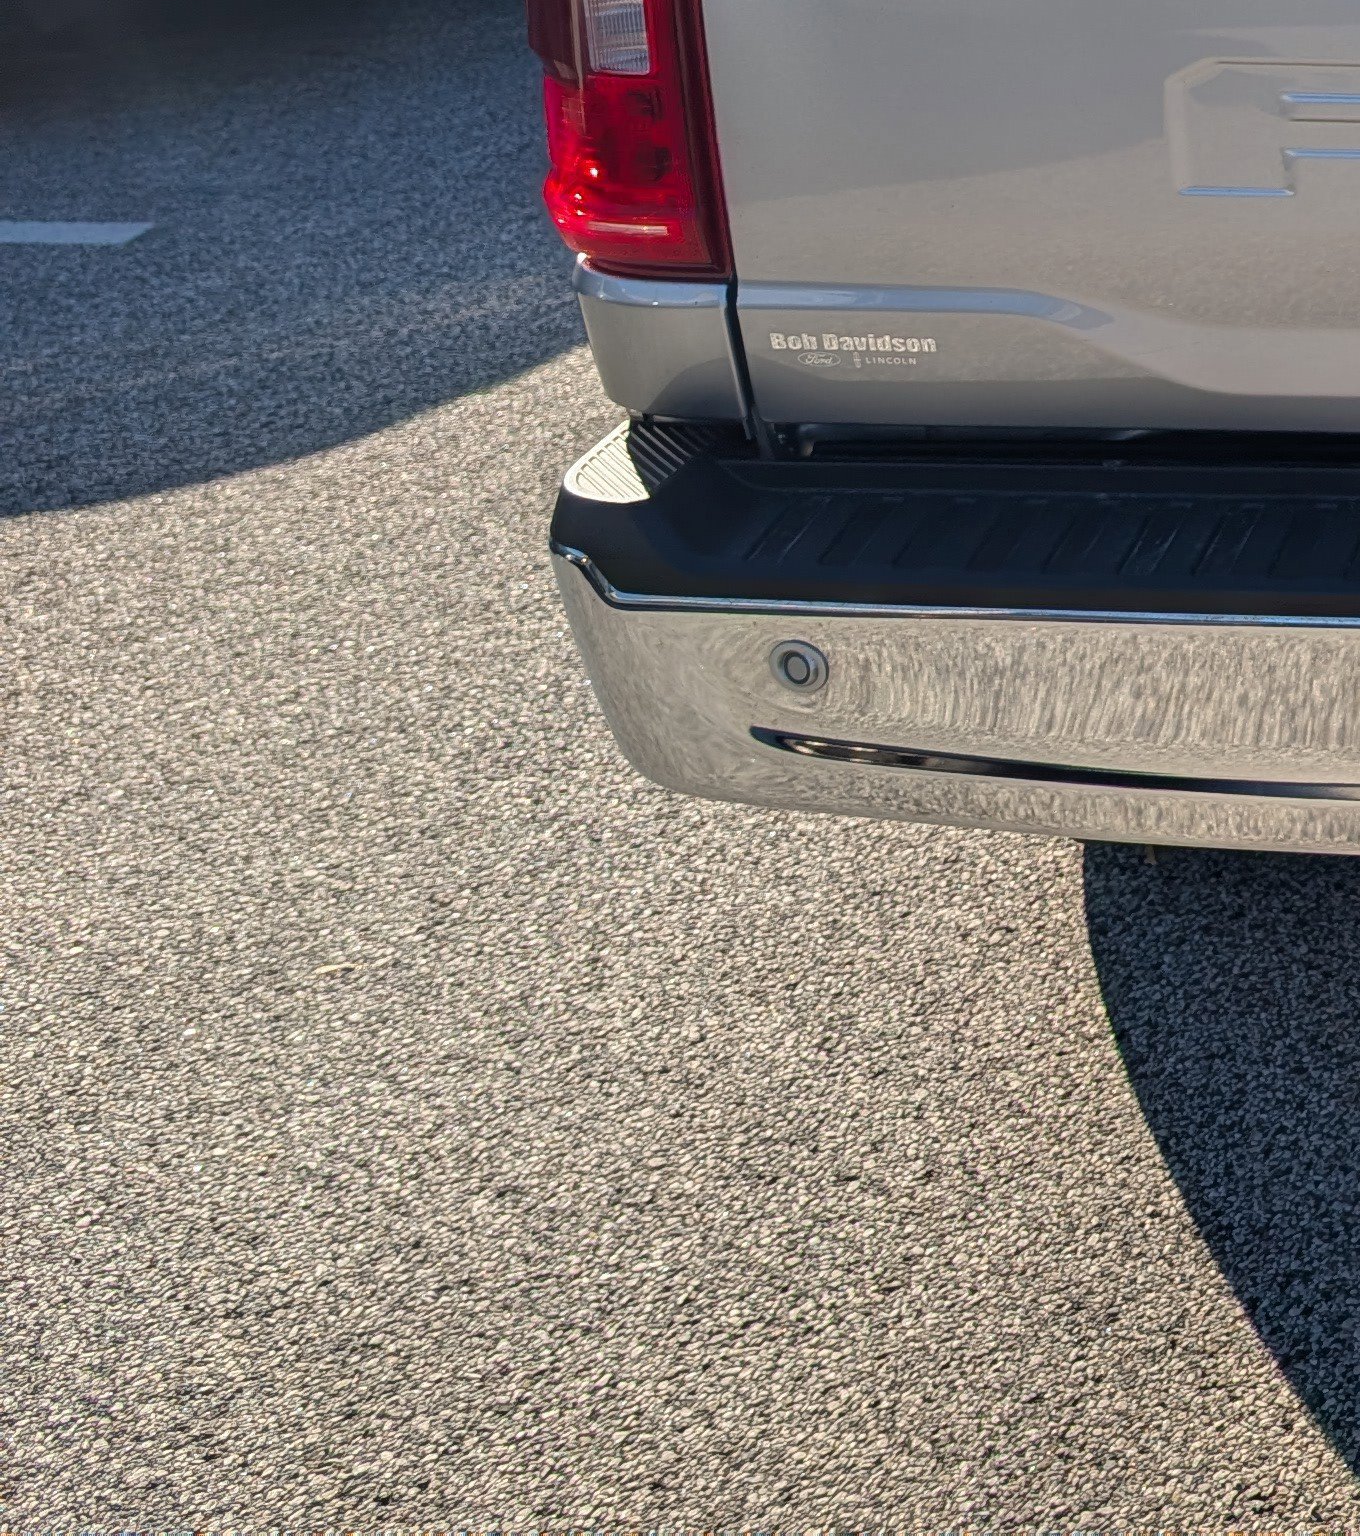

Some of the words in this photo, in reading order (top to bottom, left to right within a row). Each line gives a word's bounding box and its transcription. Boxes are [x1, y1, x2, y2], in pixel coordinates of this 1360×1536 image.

[769, 332, 818, 351] Bob
[822, 333, 937, 353] Davidson
[865, 356, 917, 365] LINCOLN
